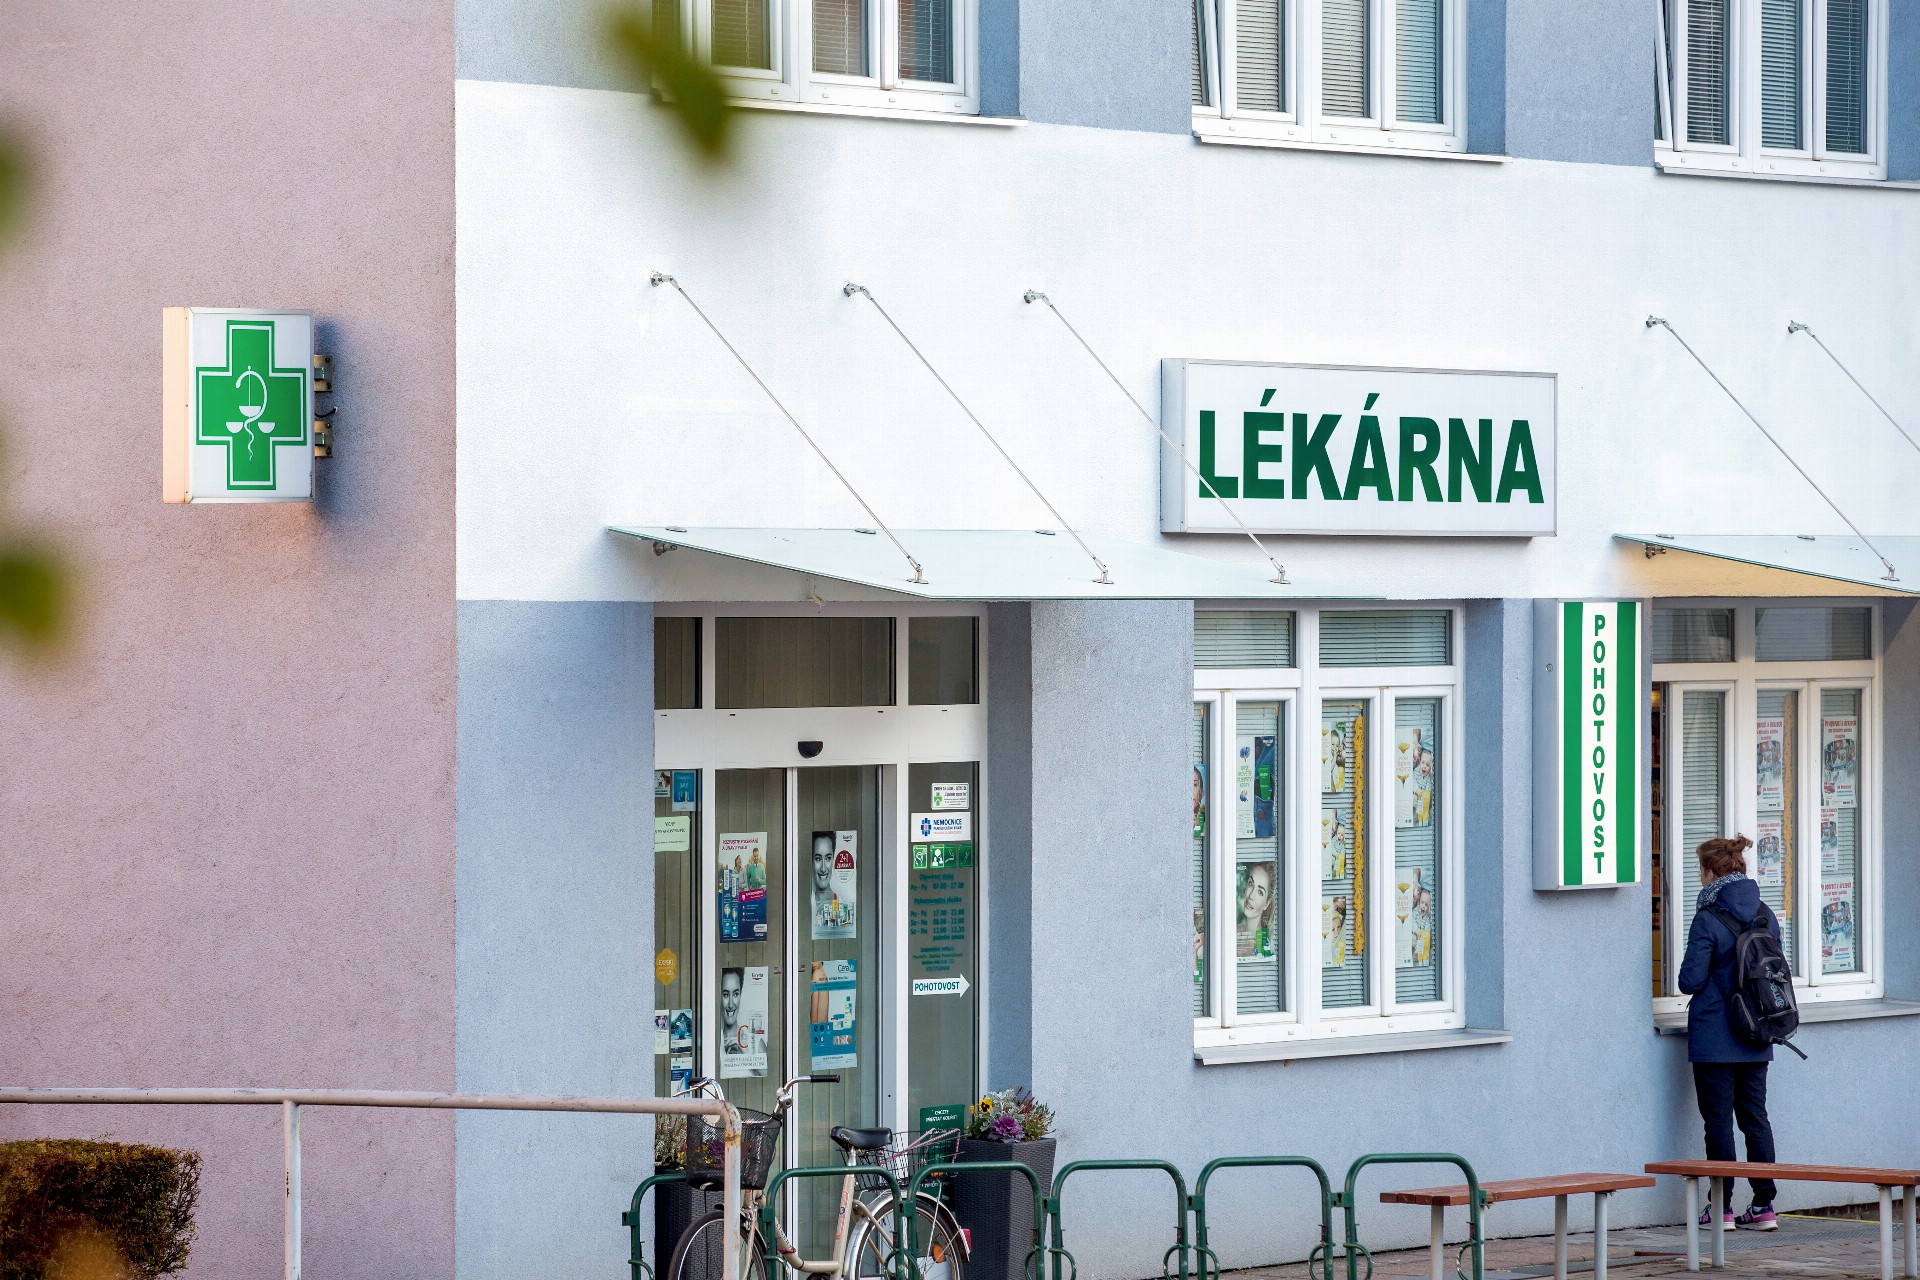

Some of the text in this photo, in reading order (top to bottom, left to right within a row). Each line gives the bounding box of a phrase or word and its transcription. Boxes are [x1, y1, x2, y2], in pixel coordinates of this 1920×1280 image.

[1199, 388, 1545, 504] LÉKÁRNA
[1592, 614, 1606, 874] POHOTOVOST
[914, 982, 960, 991] POHOTOVOST
